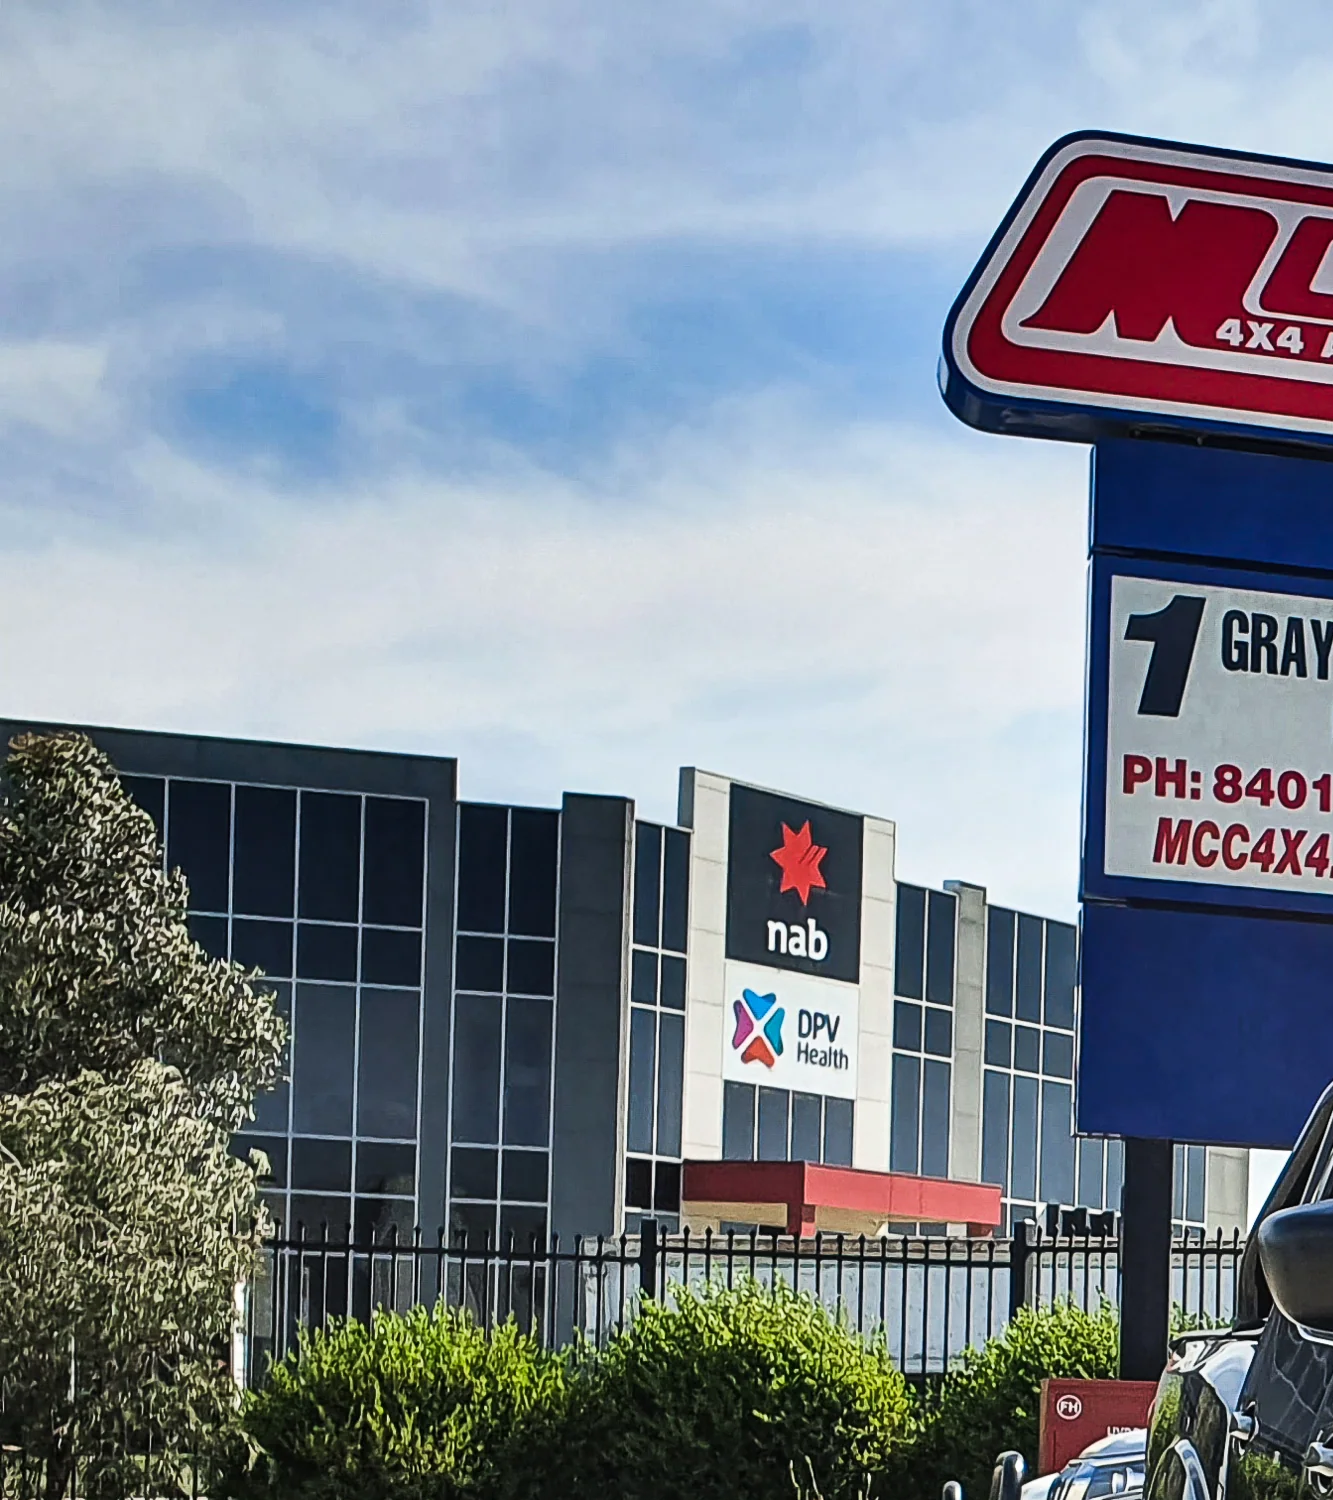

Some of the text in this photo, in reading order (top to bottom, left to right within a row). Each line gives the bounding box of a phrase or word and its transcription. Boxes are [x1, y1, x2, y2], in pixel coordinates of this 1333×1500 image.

[1215, 317, 1305, 355] 4X4
[1123, 594, 1206, 717] 1
[1122, 754, 1202, 800] PH:
[1212, 764, 1332, 812] 8401
[767, 918, 829, 961] nab
[797, 1008, 840, 1043] DPV
[797, 1042, 849, 1070] Health
[1060, 1401, 1079, 1413] FH
